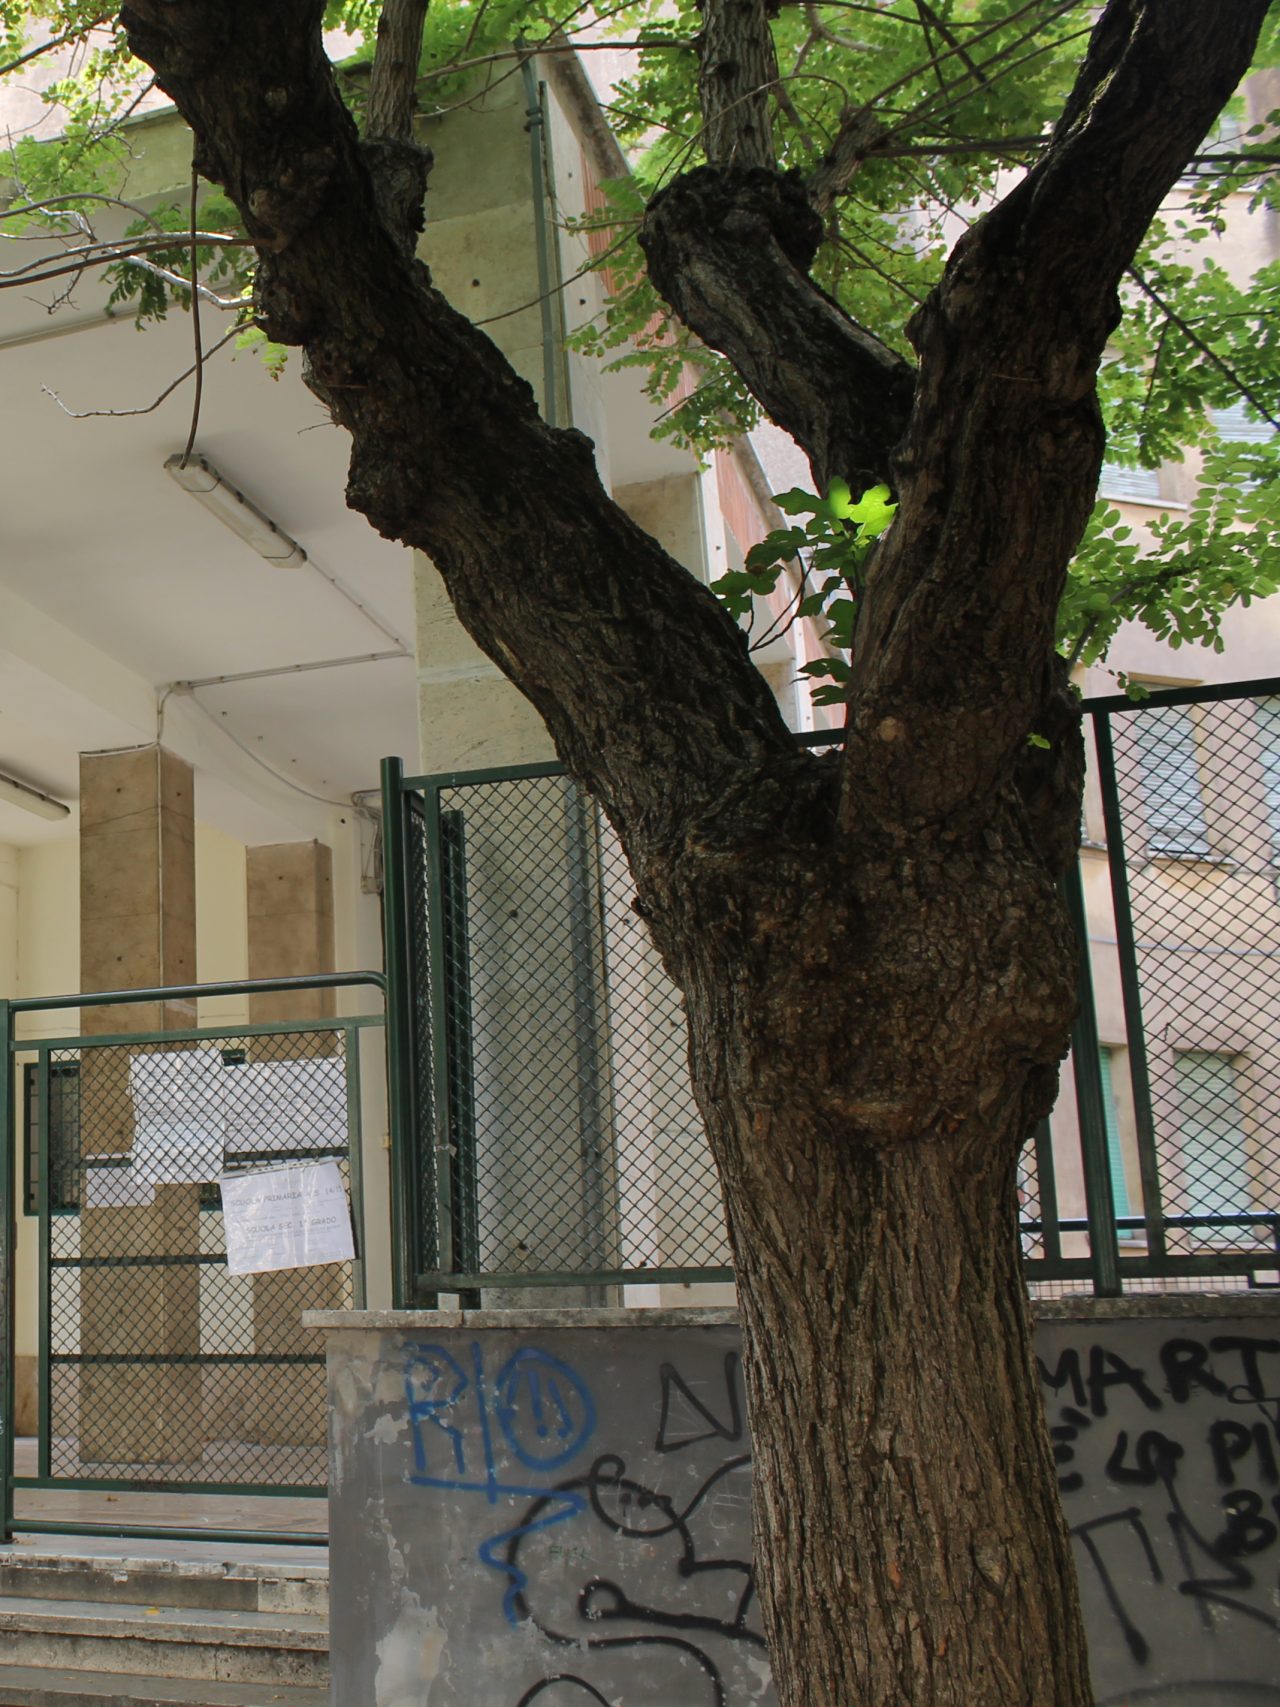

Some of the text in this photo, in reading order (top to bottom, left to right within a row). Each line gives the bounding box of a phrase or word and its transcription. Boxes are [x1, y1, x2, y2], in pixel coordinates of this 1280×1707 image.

[263, 1191, 303, 1202] PRIMARIA
[246, 1225, 275, 1234] SCUOLA
[311, 1215, 337, 1226] GRADO
